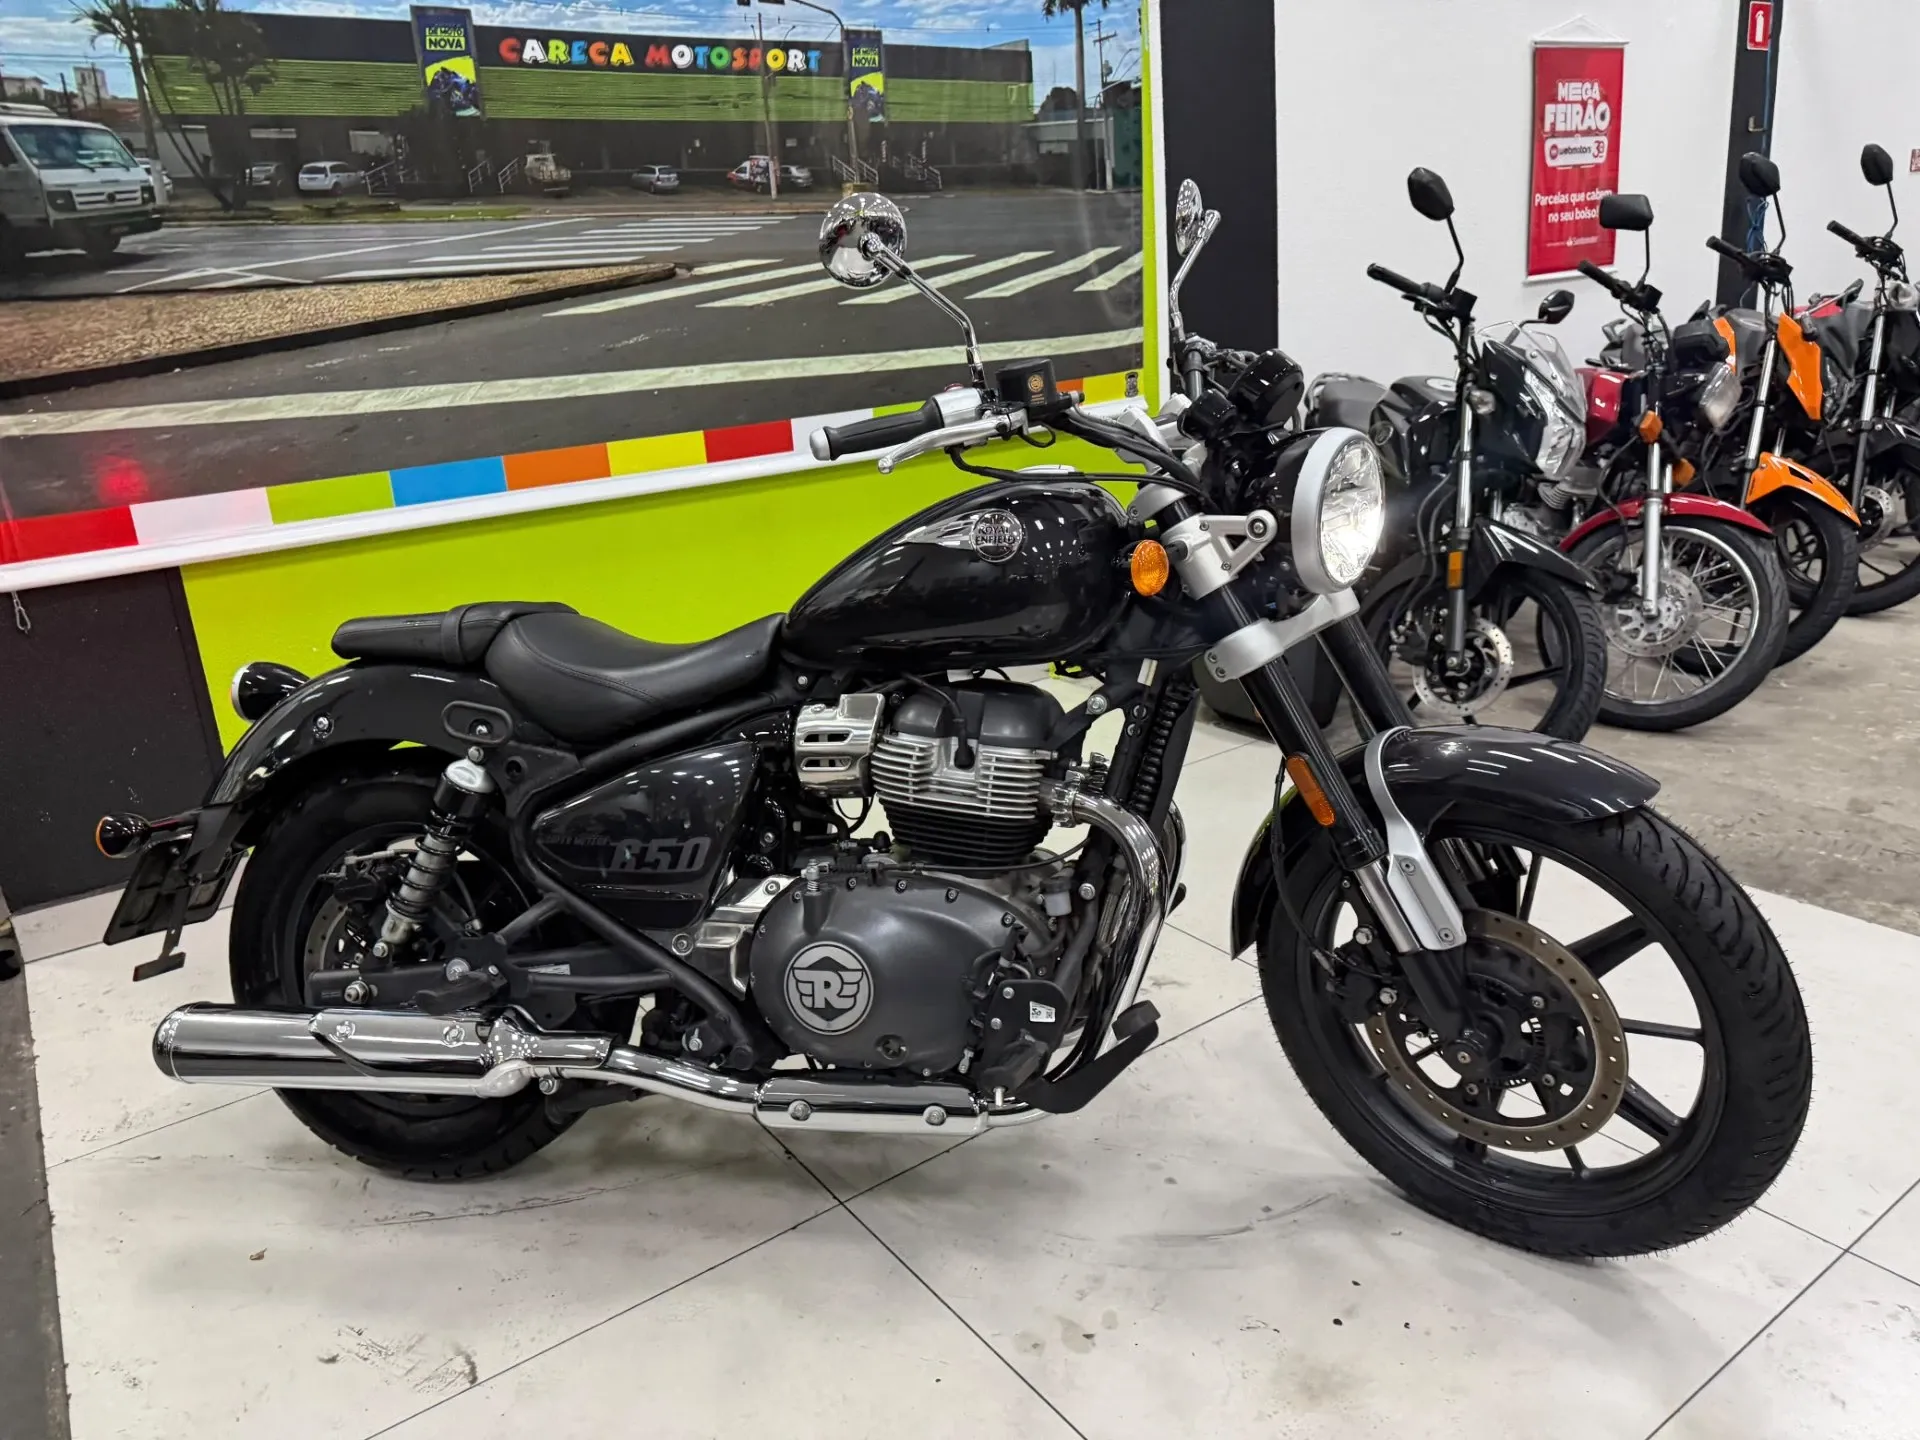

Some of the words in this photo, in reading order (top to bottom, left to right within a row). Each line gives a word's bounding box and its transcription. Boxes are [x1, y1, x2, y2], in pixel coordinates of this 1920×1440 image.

[428, 38, 463, 49] NOVA
[499, 37, 635, 66] CARECA
[645, 44, 821, 72] MOTOSPORT
[1557, 82, 1600, 101] MEGA
[1544, 99, 1611, 132] FEIRÃO
[1535, 192, 1569, 206] Parcelas
[1570, 192, 1585, 206] que
[1548, 212, 1559, 223] no
[1560, 210, 1574, 222] seu
[977, 525, 1009, 535] ROYAL
[976, 535, 1016, 545] ENFIELD
